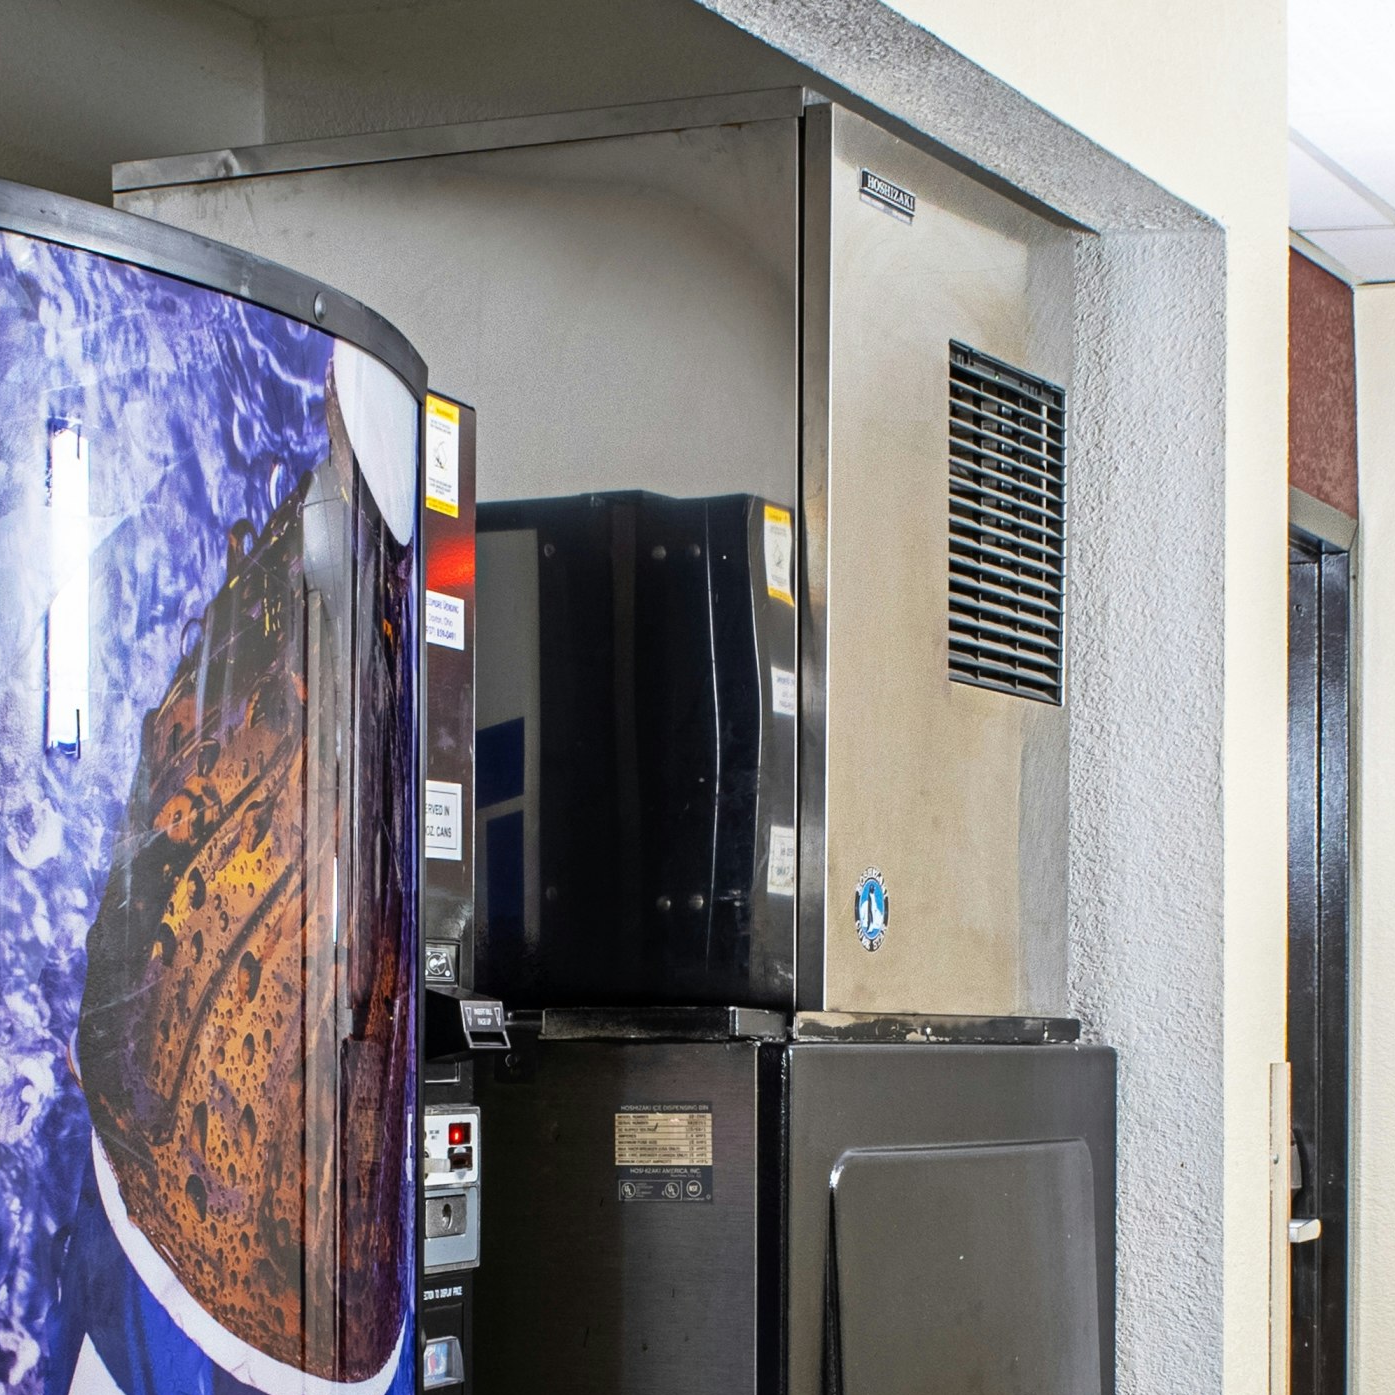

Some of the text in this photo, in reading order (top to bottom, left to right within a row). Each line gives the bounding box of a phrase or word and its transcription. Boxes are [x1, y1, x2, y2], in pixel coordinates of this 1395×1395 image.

[867, 174, 914, 209] HOSHIZAKI
[444, 806, 450, 816] IN
[436, 826, 452, 837] CANS
